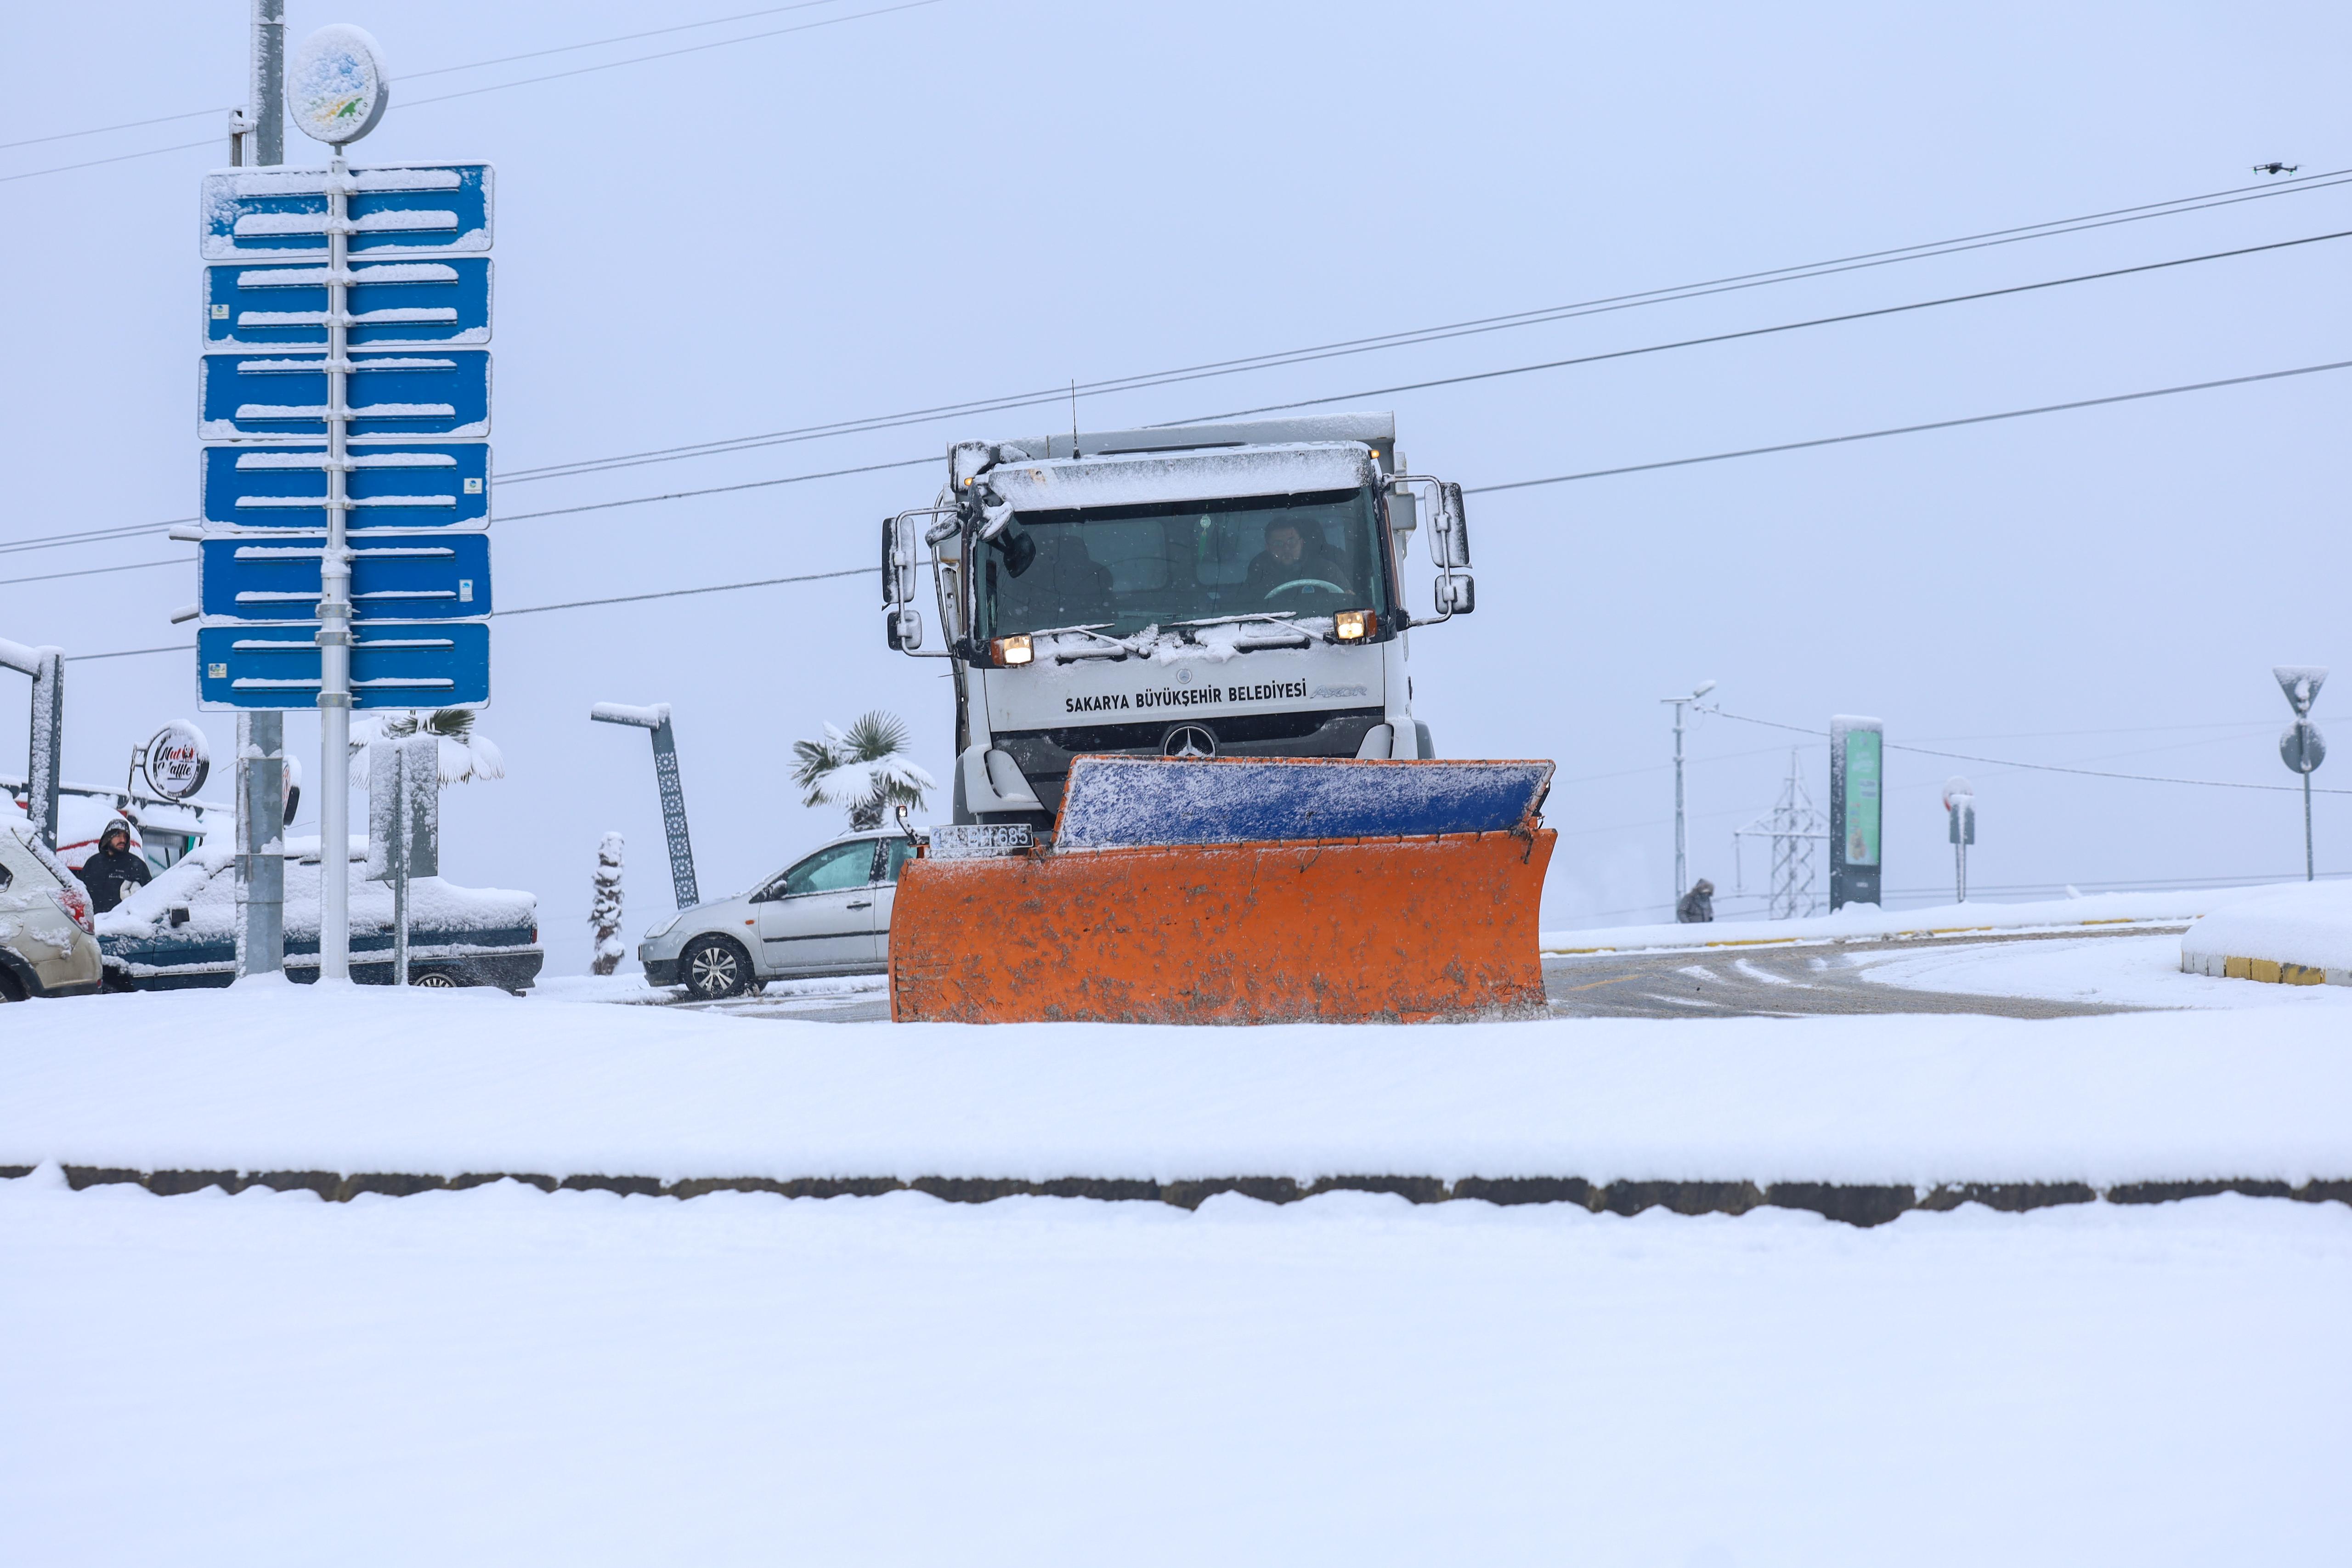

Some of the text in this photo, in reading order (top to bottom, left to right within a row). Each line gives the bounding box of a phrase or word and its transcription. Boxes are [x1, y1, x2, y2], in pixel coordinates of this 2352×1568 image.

[1066, 678, 1306, 713] SAKARYA BÜYÜKŞEHİR BELEDİYESİ
[159, 747, 181, 760] Nut
[967, 828, 992, 847] BH
[998, 827, 1029, 845] 685
